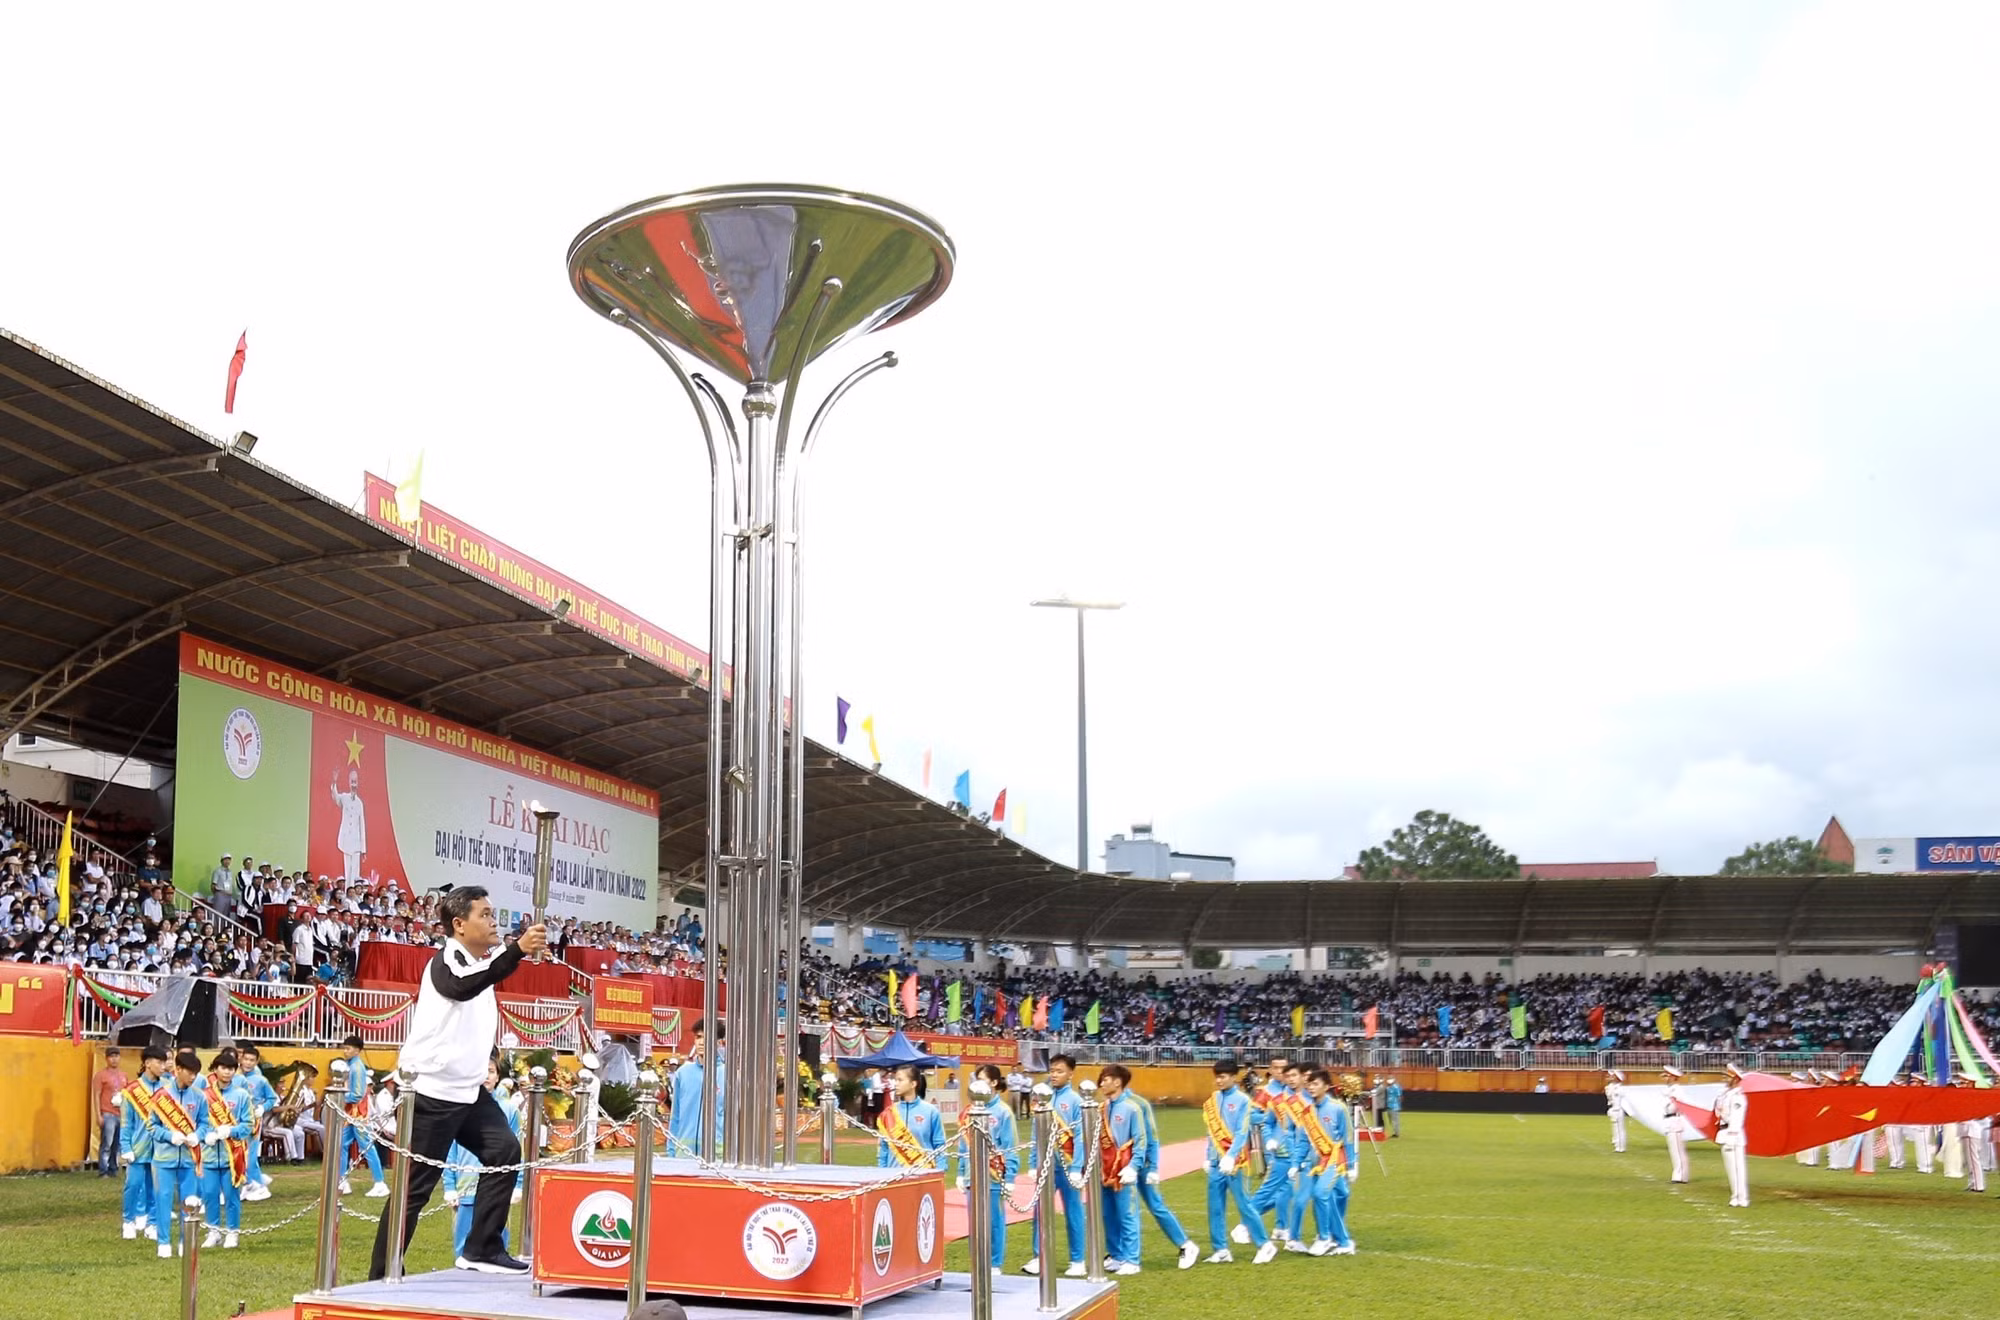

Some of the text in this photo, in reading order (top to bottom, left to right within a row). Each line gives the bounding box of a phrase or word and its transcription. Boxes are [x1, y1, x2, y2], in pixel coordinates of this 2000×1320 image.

[428, 520, 456, 554] LIỆT
[460, 537, 496, 572] CHÀO
[499, 556, 534, 592] MỪNG
[536, 576, 555, 604] ĐẠI
[579, 600, 598, 625] THỂ
[600, 610, 620, 636] DỤC
[621, 623, 640, 646] THỂ
[641, 631, 663, 658] THAO
[197, 648, 259, 684] NƯỚC
[267, 671, 323, 705] CỘNG
[330, 691, 368, 718] HÒA
[373, 704, 397, 727] XÃ
[402, 713, 430, 738] HỘI
[436, 725, 467, 748] CHỦ
[472, 739, 516, 765] NGHĨA
[520, 753, 549, 775] VIỆT
[552, 764, 581, 786] NAM
[584, 775, 619, 798] MUÔN
[622, 786, 647, 807] NĂM
[488, 785, 610, 857] LỄ KAI MẠC
[1928, 843, 1974, 863] SÂN
[435, 830, 450, 864] ĐẠI
[452, 830, 466, 868] HỘI
[468, 830, 484, 866] THỂ
[485, 841, 500, 874] DỤC
[503, 838, 517, 873] THỂ
[556, 859, 568, 885] GIA
[569, 861, 580, 887] LAI
[616, 870, 631, 897] NĂM
[631, 877, 646, 901] 2022
[591, 1247, 621, 1259] GIA LAI
[772, 1257, 789, 1265] 2022
